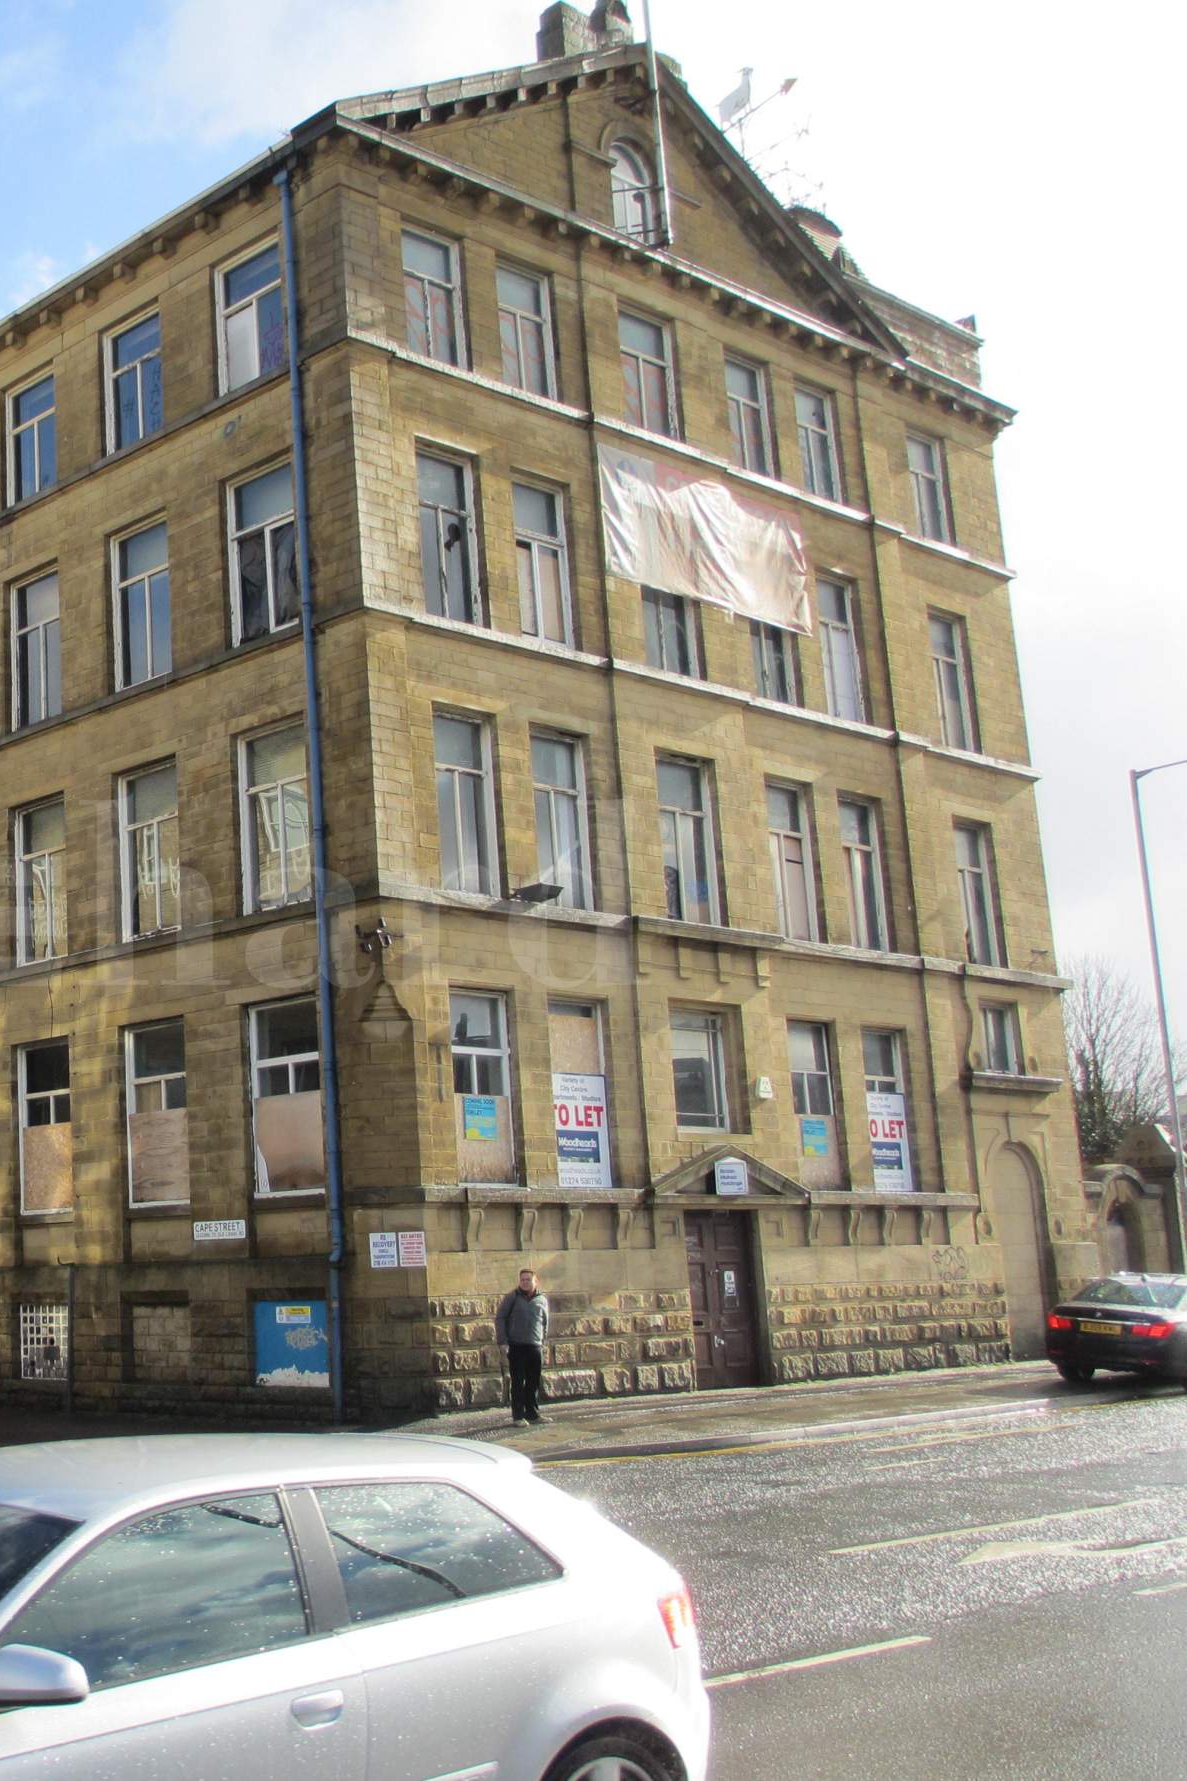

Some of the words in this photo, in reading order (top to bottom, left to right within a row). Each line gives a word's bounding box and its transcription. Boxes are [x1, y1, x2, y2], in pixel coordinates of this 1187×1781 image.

[574, 1105, 604, 1127] LET
[870, 1119, 878, 1138] O
[882, 1119, 905, 1139] LET
[195, 1222, 213, 1233] CAPE
[214, 1221, 240, 1232] STREET
